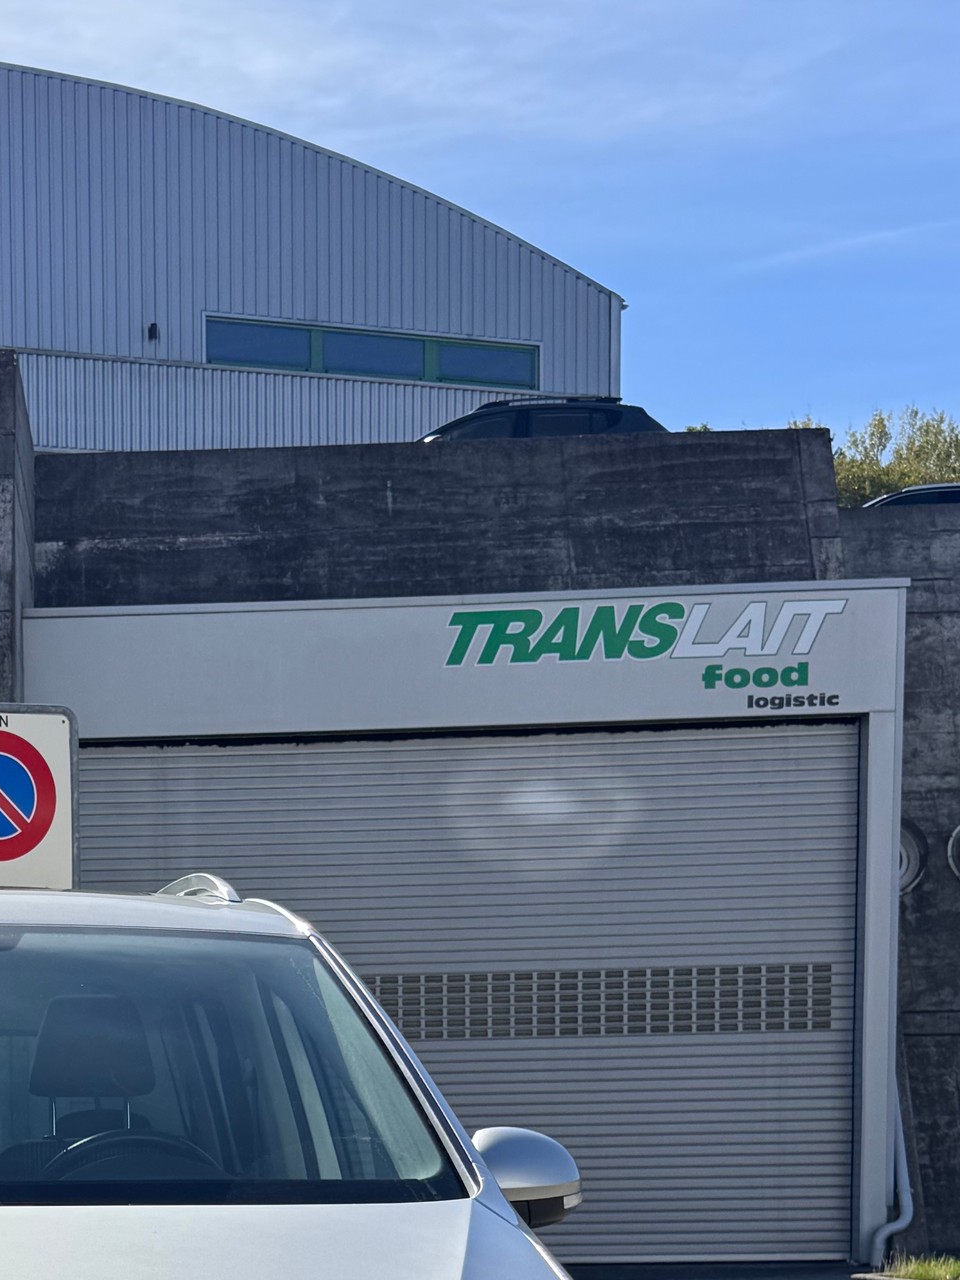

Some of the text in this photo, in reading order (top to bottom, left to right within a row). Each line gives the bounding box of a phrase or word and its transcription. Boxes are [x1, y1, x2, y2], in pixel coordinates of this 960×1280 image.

[444, 598, 848, 667] TRANSLAIT
[701, 662, 810, 689] food
[746, 693, 840, 710] logistic
